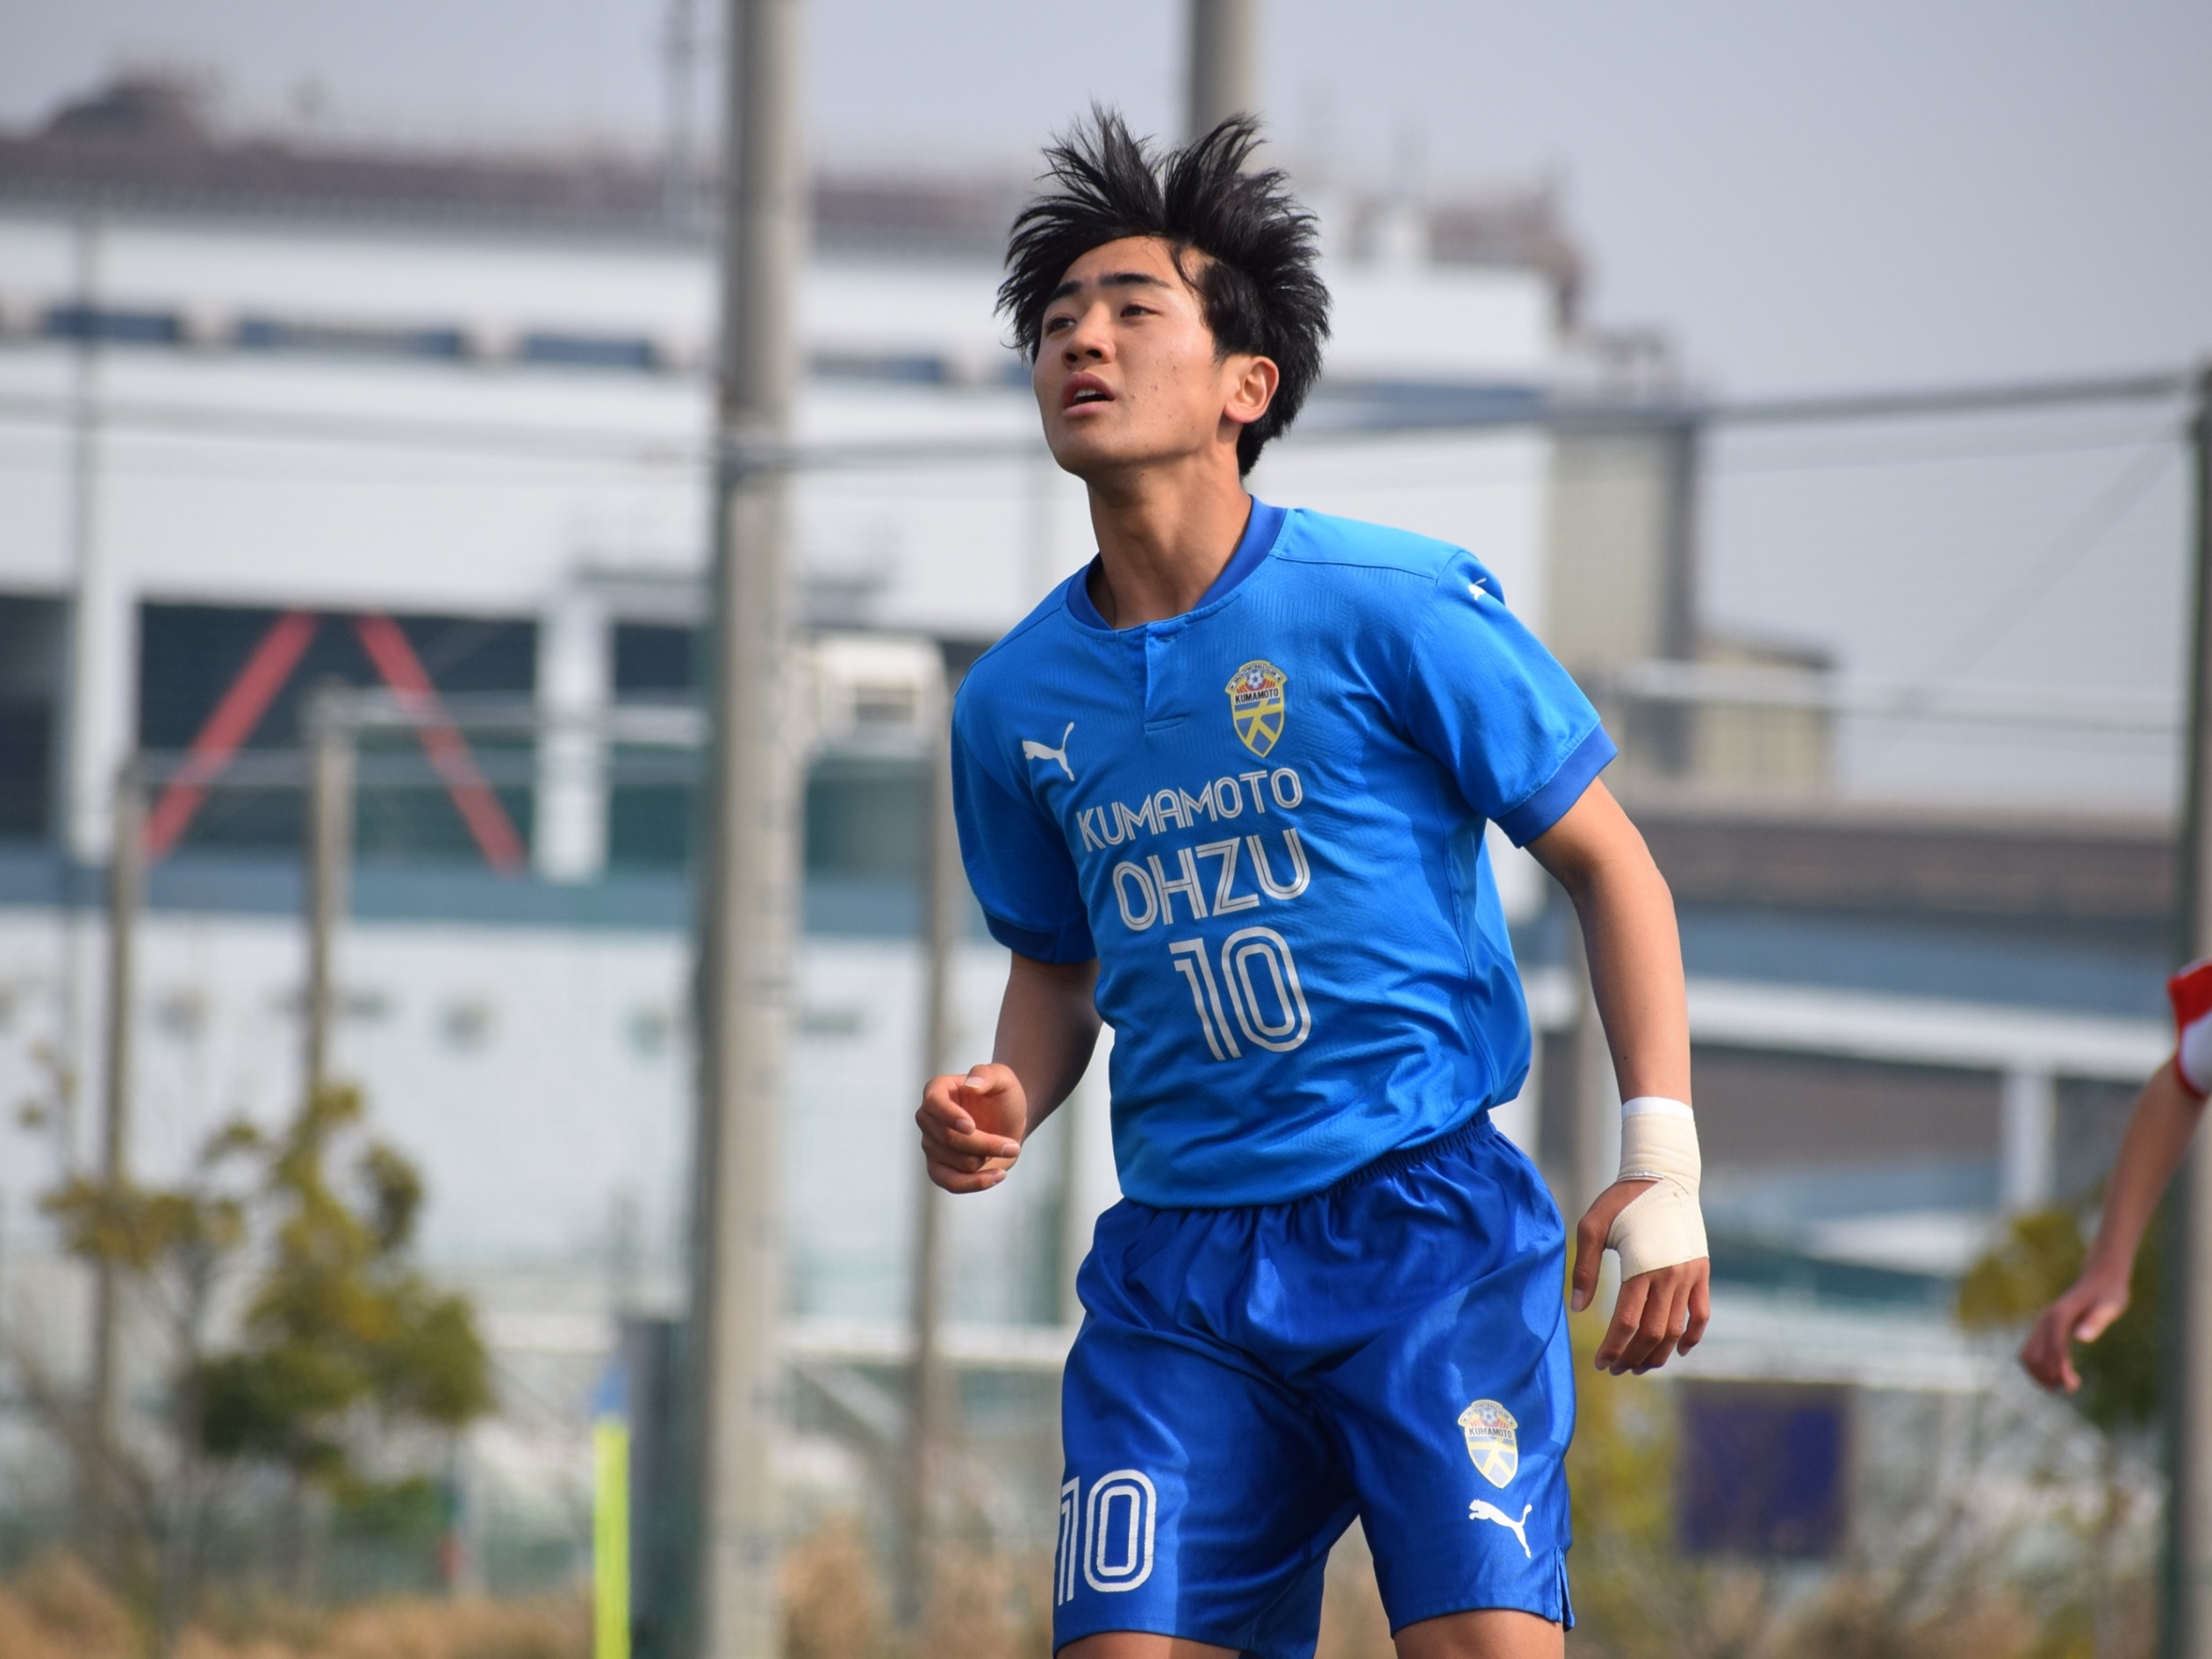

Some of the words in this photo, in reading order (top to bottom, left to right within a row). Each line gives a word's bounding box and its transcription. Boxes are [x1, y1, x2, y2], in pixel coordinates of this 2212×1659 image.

[1235, 688, 1278, 704] KUMAMOTO
[1077, 768, 1303, 852] KUMAMOTO
[1113, 828, 1311, 931] OHZU
[1169, 926, 1311, 1061] 10
[1469, 1427, 1512, 1439] KUMAMOTO
[1058, 1469, 1156, 1606] 10
